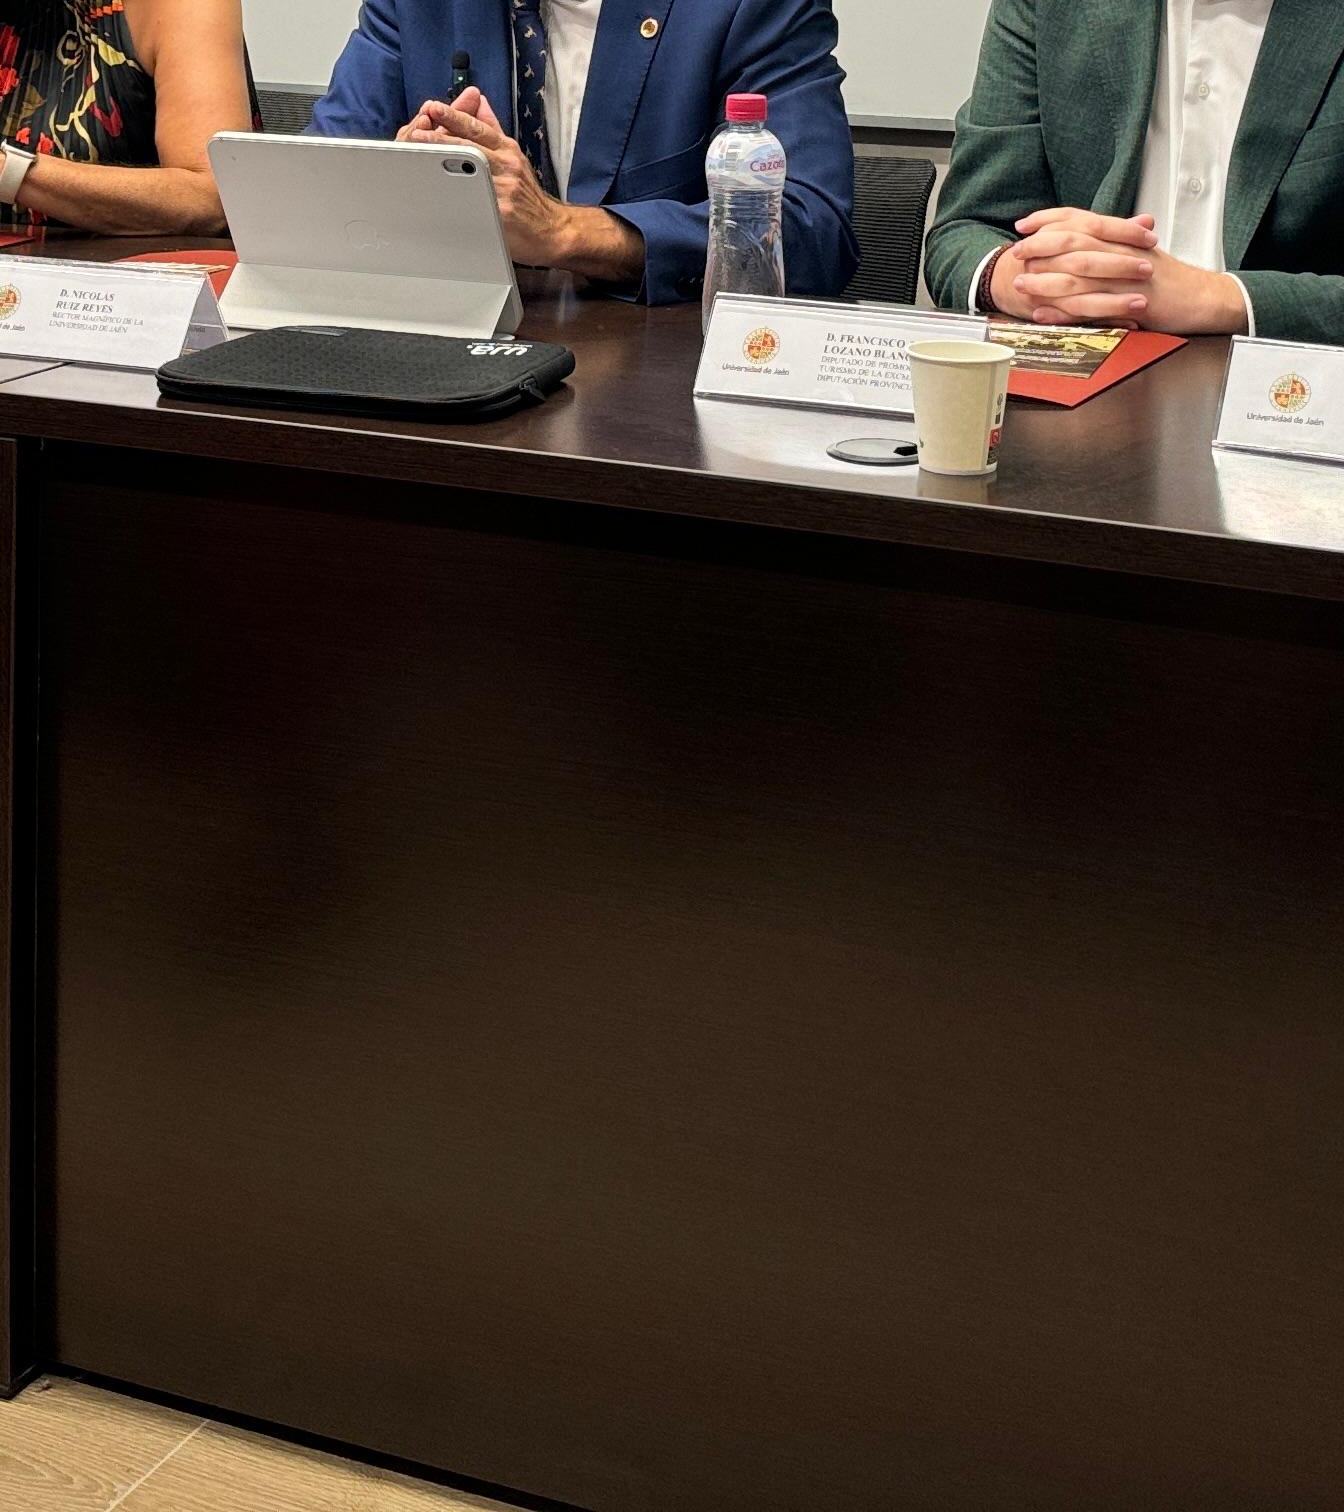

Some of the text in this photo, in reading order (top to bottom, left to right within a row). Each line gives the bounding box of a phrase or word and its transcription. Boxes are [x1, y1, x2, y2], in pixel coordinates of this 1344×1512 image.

[60, 289, 115, 302] D. NICOLÁS
[56, 300, 113, 313] RUIZ REYES
[827, 333, 836, 342] D.
[840, 334, 906, 348] FRANCISCO
[824, 345, 871, 356] LOZANO
[722, 363, 789, 376] Universidad de Jaén
[1246, 412, 1324, 426] Universidad de Jaén
